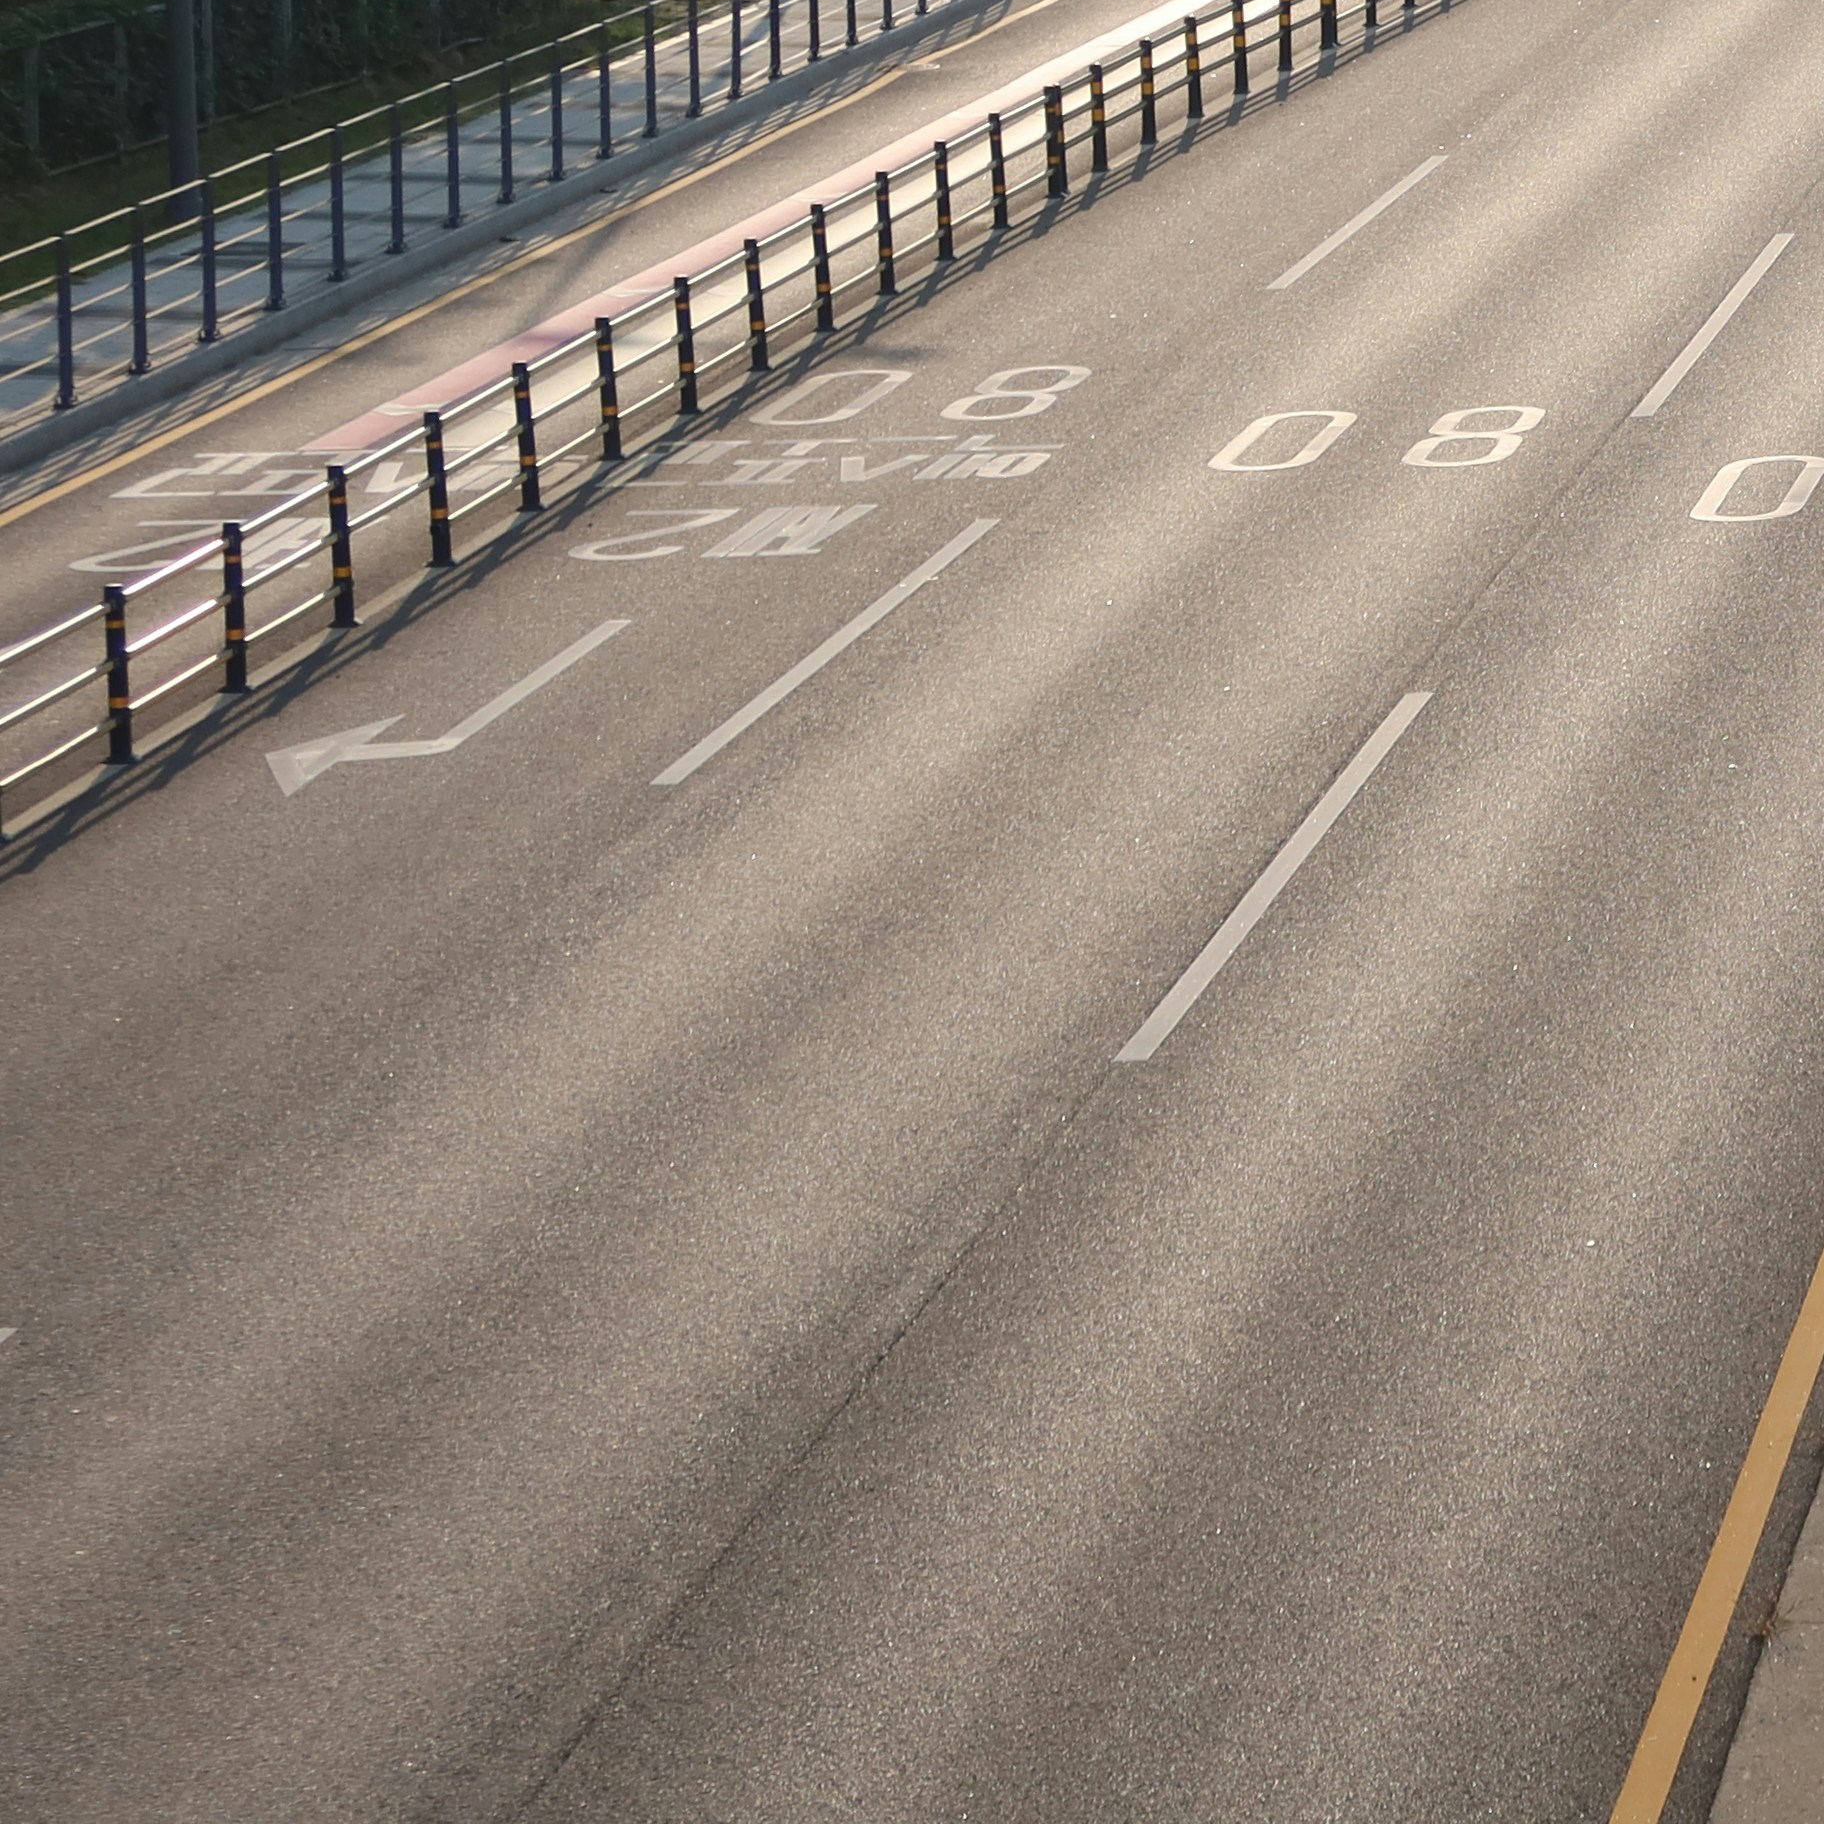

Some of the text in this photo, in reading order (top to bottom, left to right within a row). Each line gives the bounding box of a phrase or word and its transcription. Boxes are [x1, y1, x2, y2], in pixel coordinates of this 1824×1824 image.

[750, 364, 1093, 428] 80
[1206, 404, 1548, 473] 80
[568, 503, 878, 561] 제2
